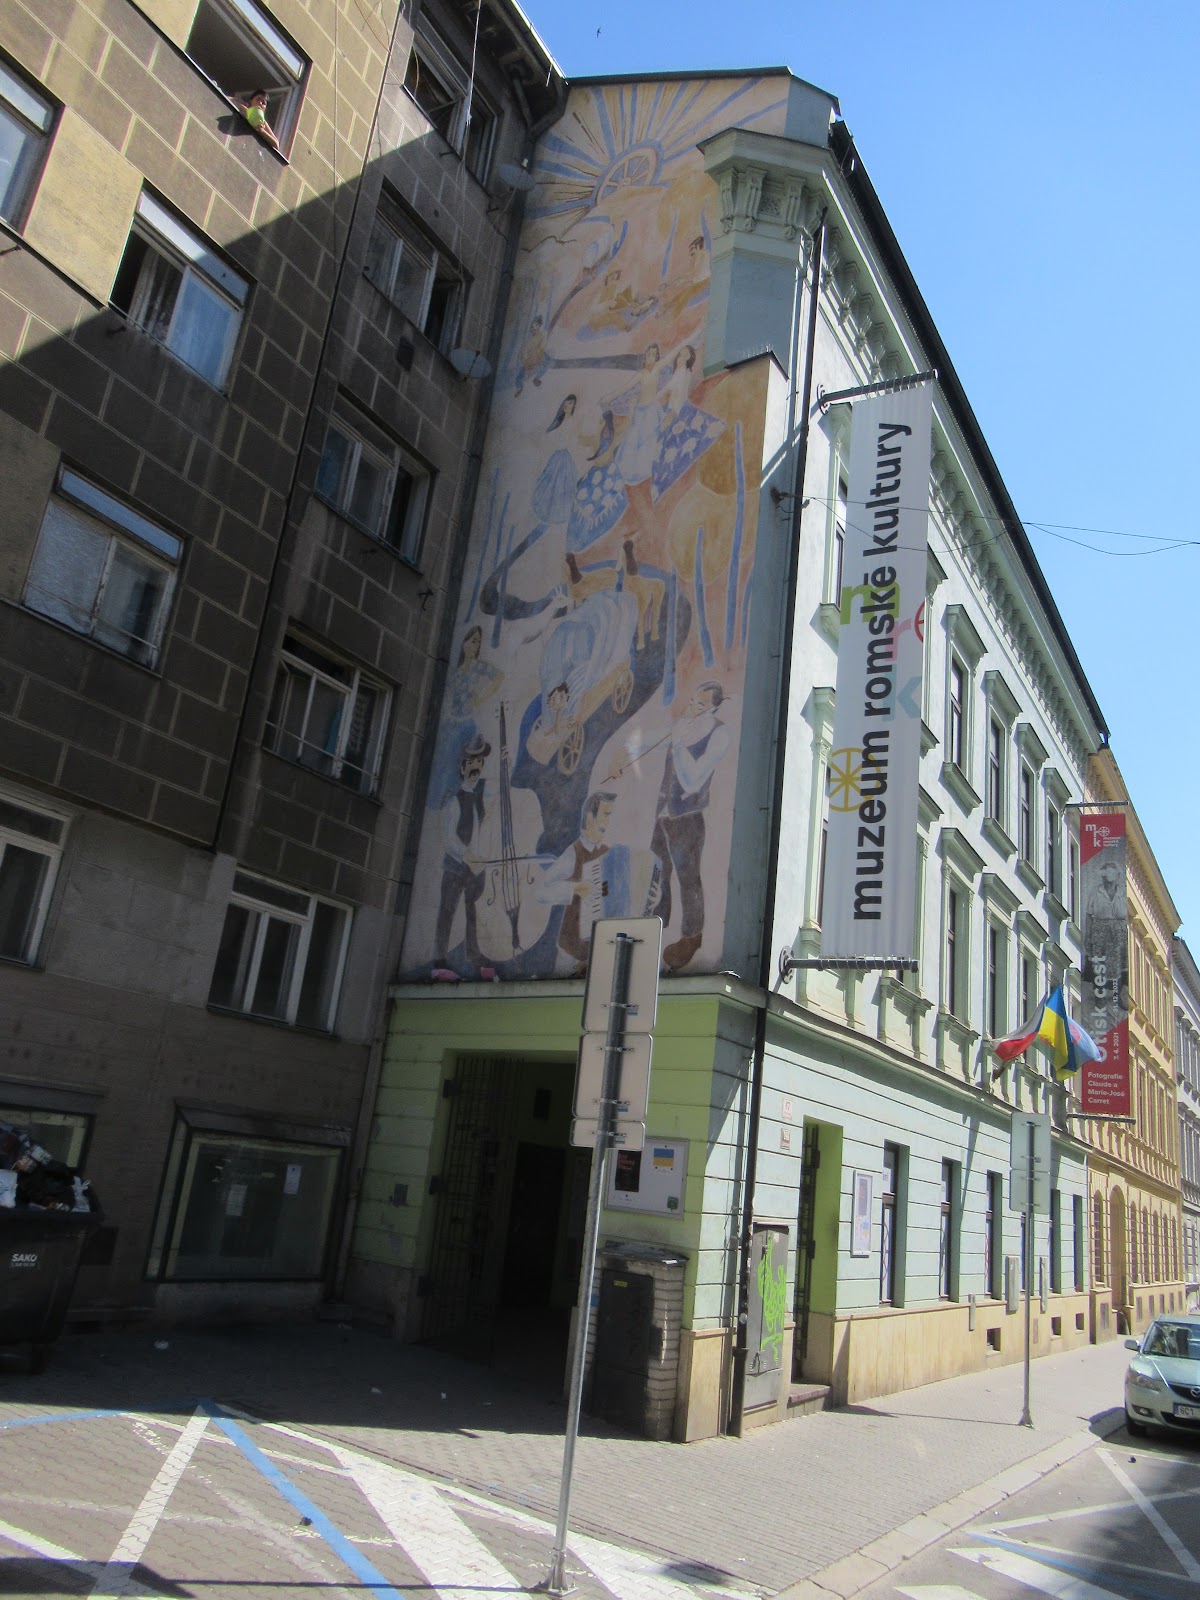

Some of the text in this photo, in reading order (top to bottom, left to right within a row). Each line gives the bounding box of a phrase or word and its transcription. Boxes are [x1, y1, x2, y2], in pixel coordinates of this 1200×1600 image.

[863, 423, 912, 557] kultury
[853, 730, 890, 920] muzeum
[1091, 955, 1108, 999] cest
[1087, 1071, 1123, 1080] Fotografie
[1087, 1080, 1112, 1088] Claude
[1087, 1088, 1126, 1097] Marie-José
[1087, 1097, 1110, 1105] Carret
[12, 1253, 38, 1262] SAKO
